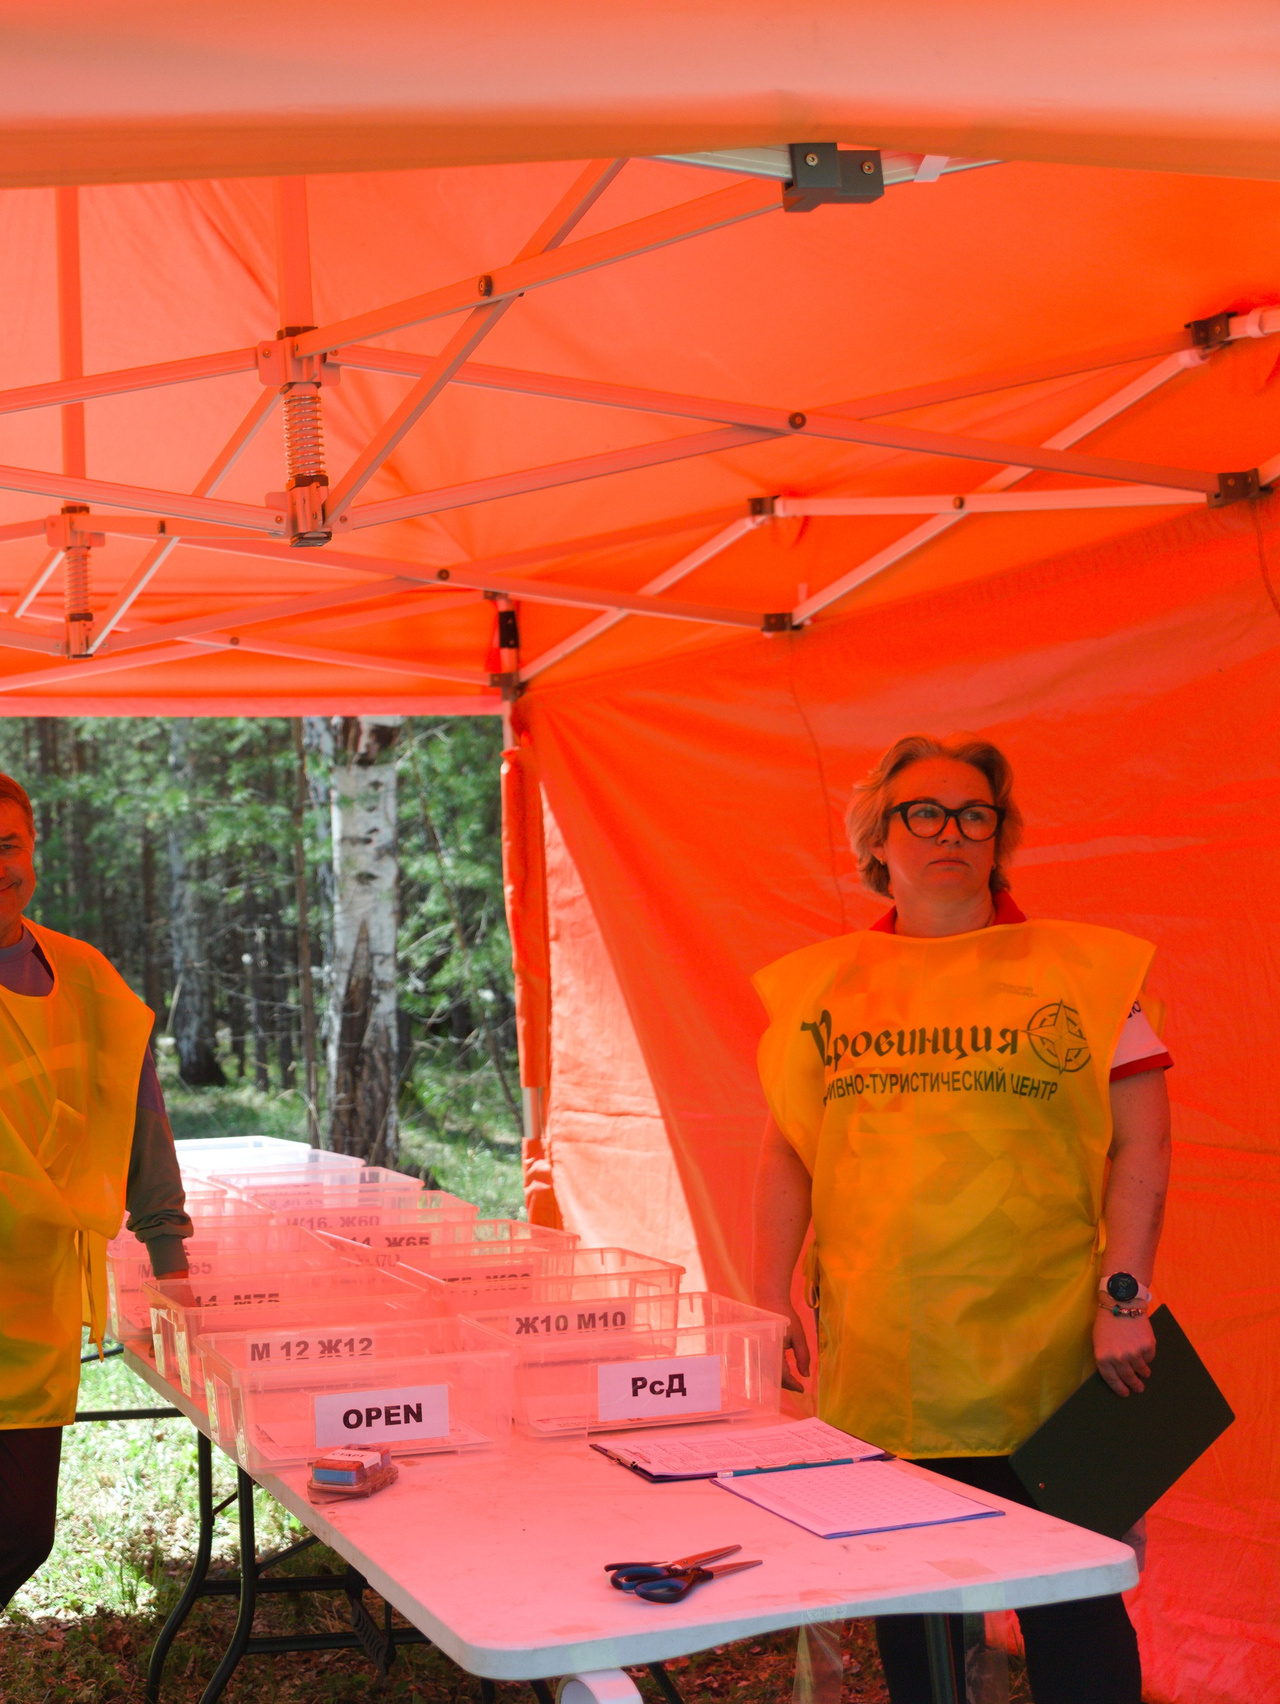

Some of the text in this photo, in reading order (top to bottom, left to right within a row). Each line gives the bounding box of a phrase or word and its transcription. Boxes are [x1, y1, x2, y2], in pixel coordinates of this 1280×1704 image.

[1010, 1073, 1059, 1101] ЦЕНТР
[515, 1311, 626, 1336] Ж10 М10
[250, 1337, 373, 1361] М 12 Ж12
[631, 1373, 687, 1398] РсД
[342, 1402, 423, 1430] OPEN
